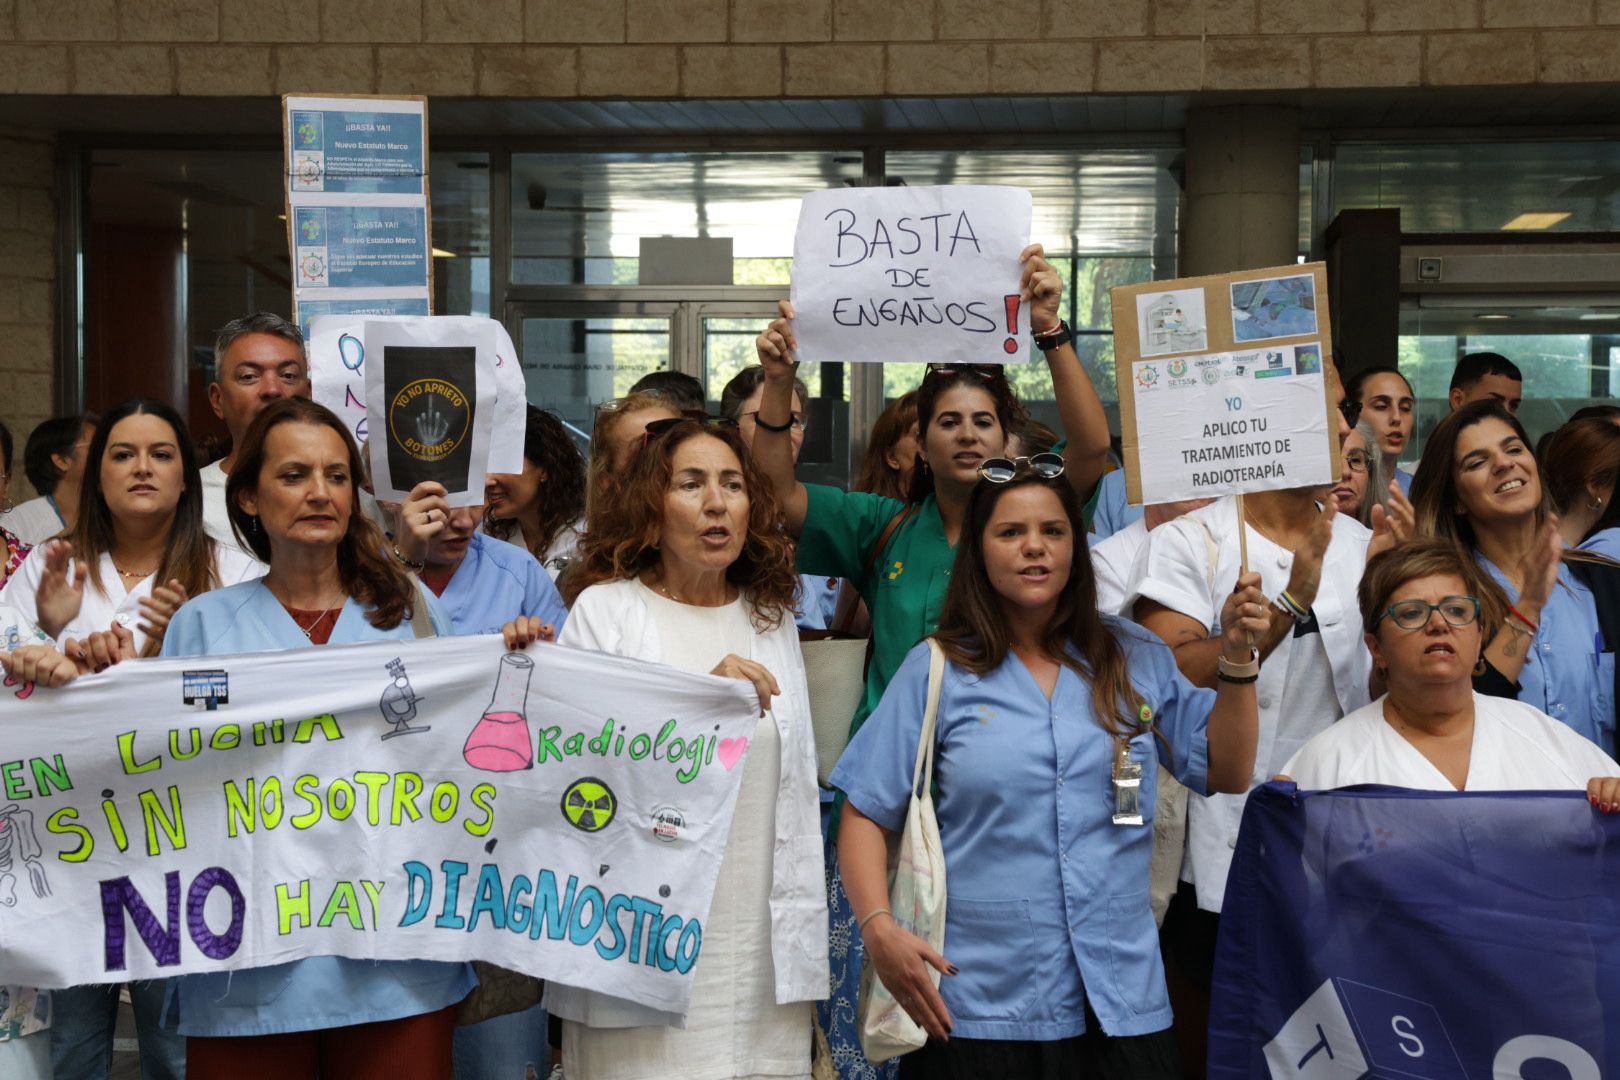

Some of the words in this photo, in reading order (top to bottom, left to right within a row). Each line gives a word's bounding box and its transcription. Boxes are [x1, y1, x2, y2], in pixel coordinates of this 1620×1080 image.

[377, 124, 391, 132] YA!!
[824, 208, 980, 268] BASTA
[884, 268, 931, 288] DE
[396, 394, 410, 407] YO
[408, 385, 422, 398] NO
[424, 383, 462, 407] APRIETO
[1225, 396, 1242, 412] YO
[1202, 419, 1247, 438] APLICO
[1250, 417, 1267, 432] TU
[405, 438, 454, 455] BOTONES
[1182, 442, 1273, 464] TRATAMIENTO
[1275, 439, 1291, 453] DE
[1193, 461, 1285, 486] RADIOTERAPÍA
[184, 685, 211, 698] HUELGA
[213, 684, 227, 697] TSS
[1, 754, 73, 801] EN
[224, 771, 497, 838] NOSOTROS
[99, 866, 246, 973] NO
[275, 880, 385, 936] HAY
[1298, 1023, 1334, 1070] T
[1391, 1015, 1425, 1058] S
